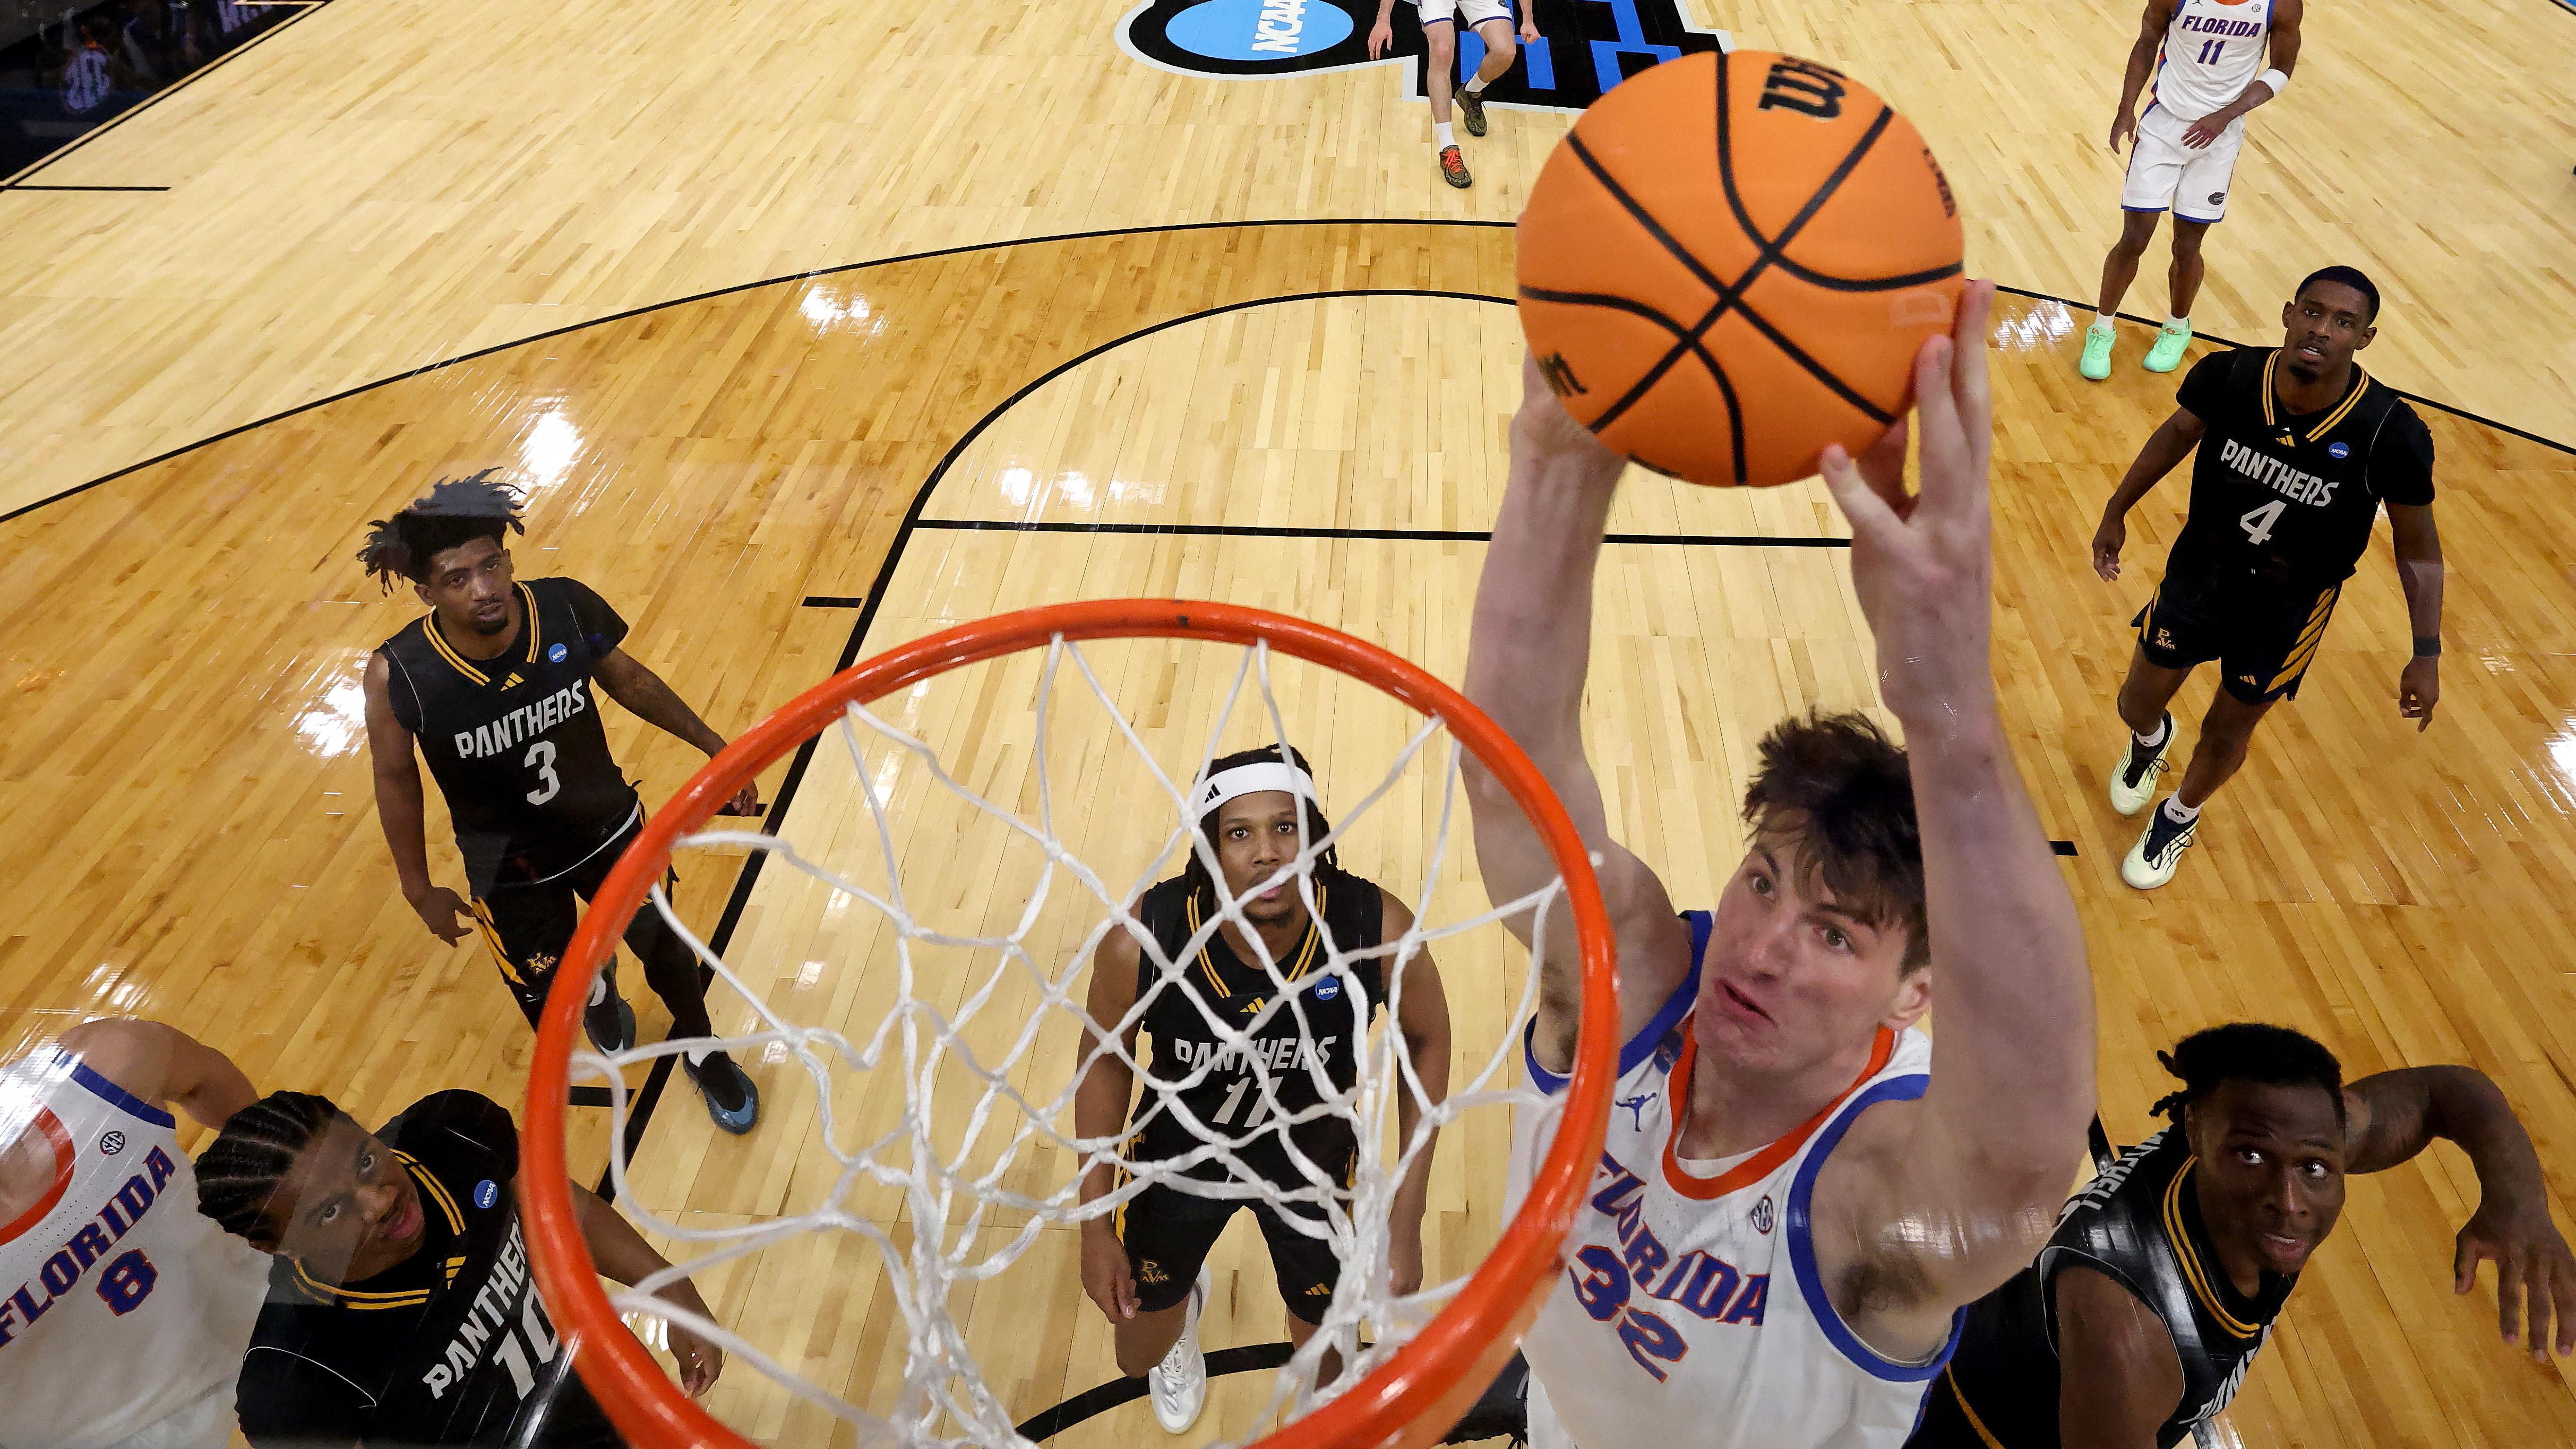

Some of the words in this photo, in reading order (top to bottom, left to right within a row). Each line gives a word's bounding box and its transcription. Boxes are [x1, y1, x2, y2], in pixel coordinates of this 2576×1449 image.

[1251, 0, 1308, 53] NCAA
[2182, 15, 2262, 37] FLORIDA
[2197, 39, 2226, 65] 11
[2220, 438, 2339, 507] PANTHERS
[2240, 500, 2287, 545] 4
[552, 649, 567, 660] NCAA
[454, 678, 585, 758] PANTHERS
[524, 740, 560, 805] 3
[1318, 987, 1337, 996] NCAA
[1212, 1077, 1283, 1127] 11
[483, 1183, 495, 1206] NCAA
[0, 1144, 176, 1348] FLORIDA
[96, 1248, 159, 1316] 8
[422, 1222, 526, 1399] PANTHER
[493, 1277, 559, 1400] 10
[1567, 1244, 1689, 1383] 32
